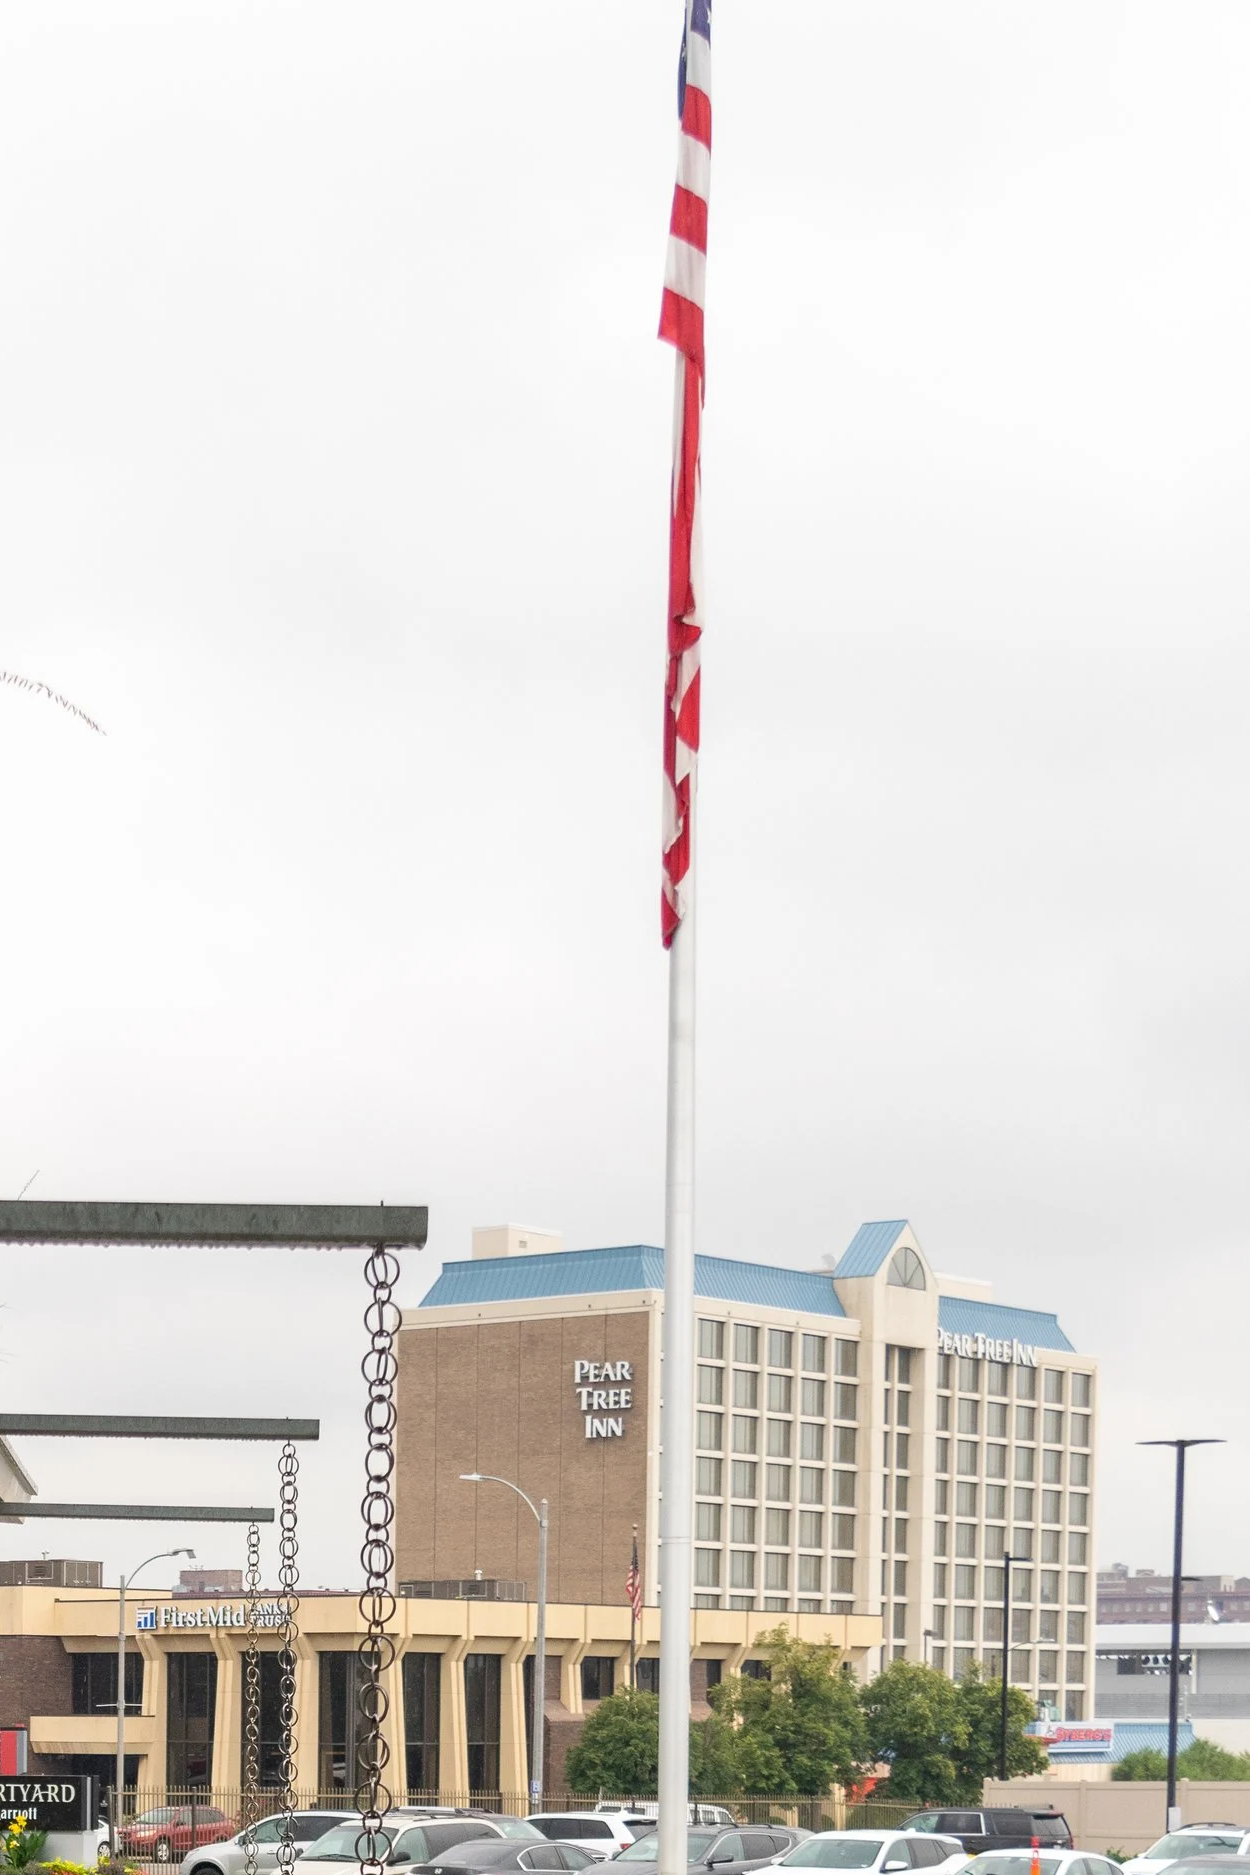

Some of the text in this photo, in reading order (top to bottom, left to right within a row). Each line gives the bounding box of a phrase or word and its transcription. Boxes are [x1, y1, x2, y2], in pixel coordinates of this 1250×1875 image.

[974, 1333, 1011, 1363] TREE
[1012, 1338, 1038, 1367] INN
[574, 1360, 632, 1383] PEAR
[576, 1387, 632, 1411] TREE
[585, 1415, 623, 1438] INN
